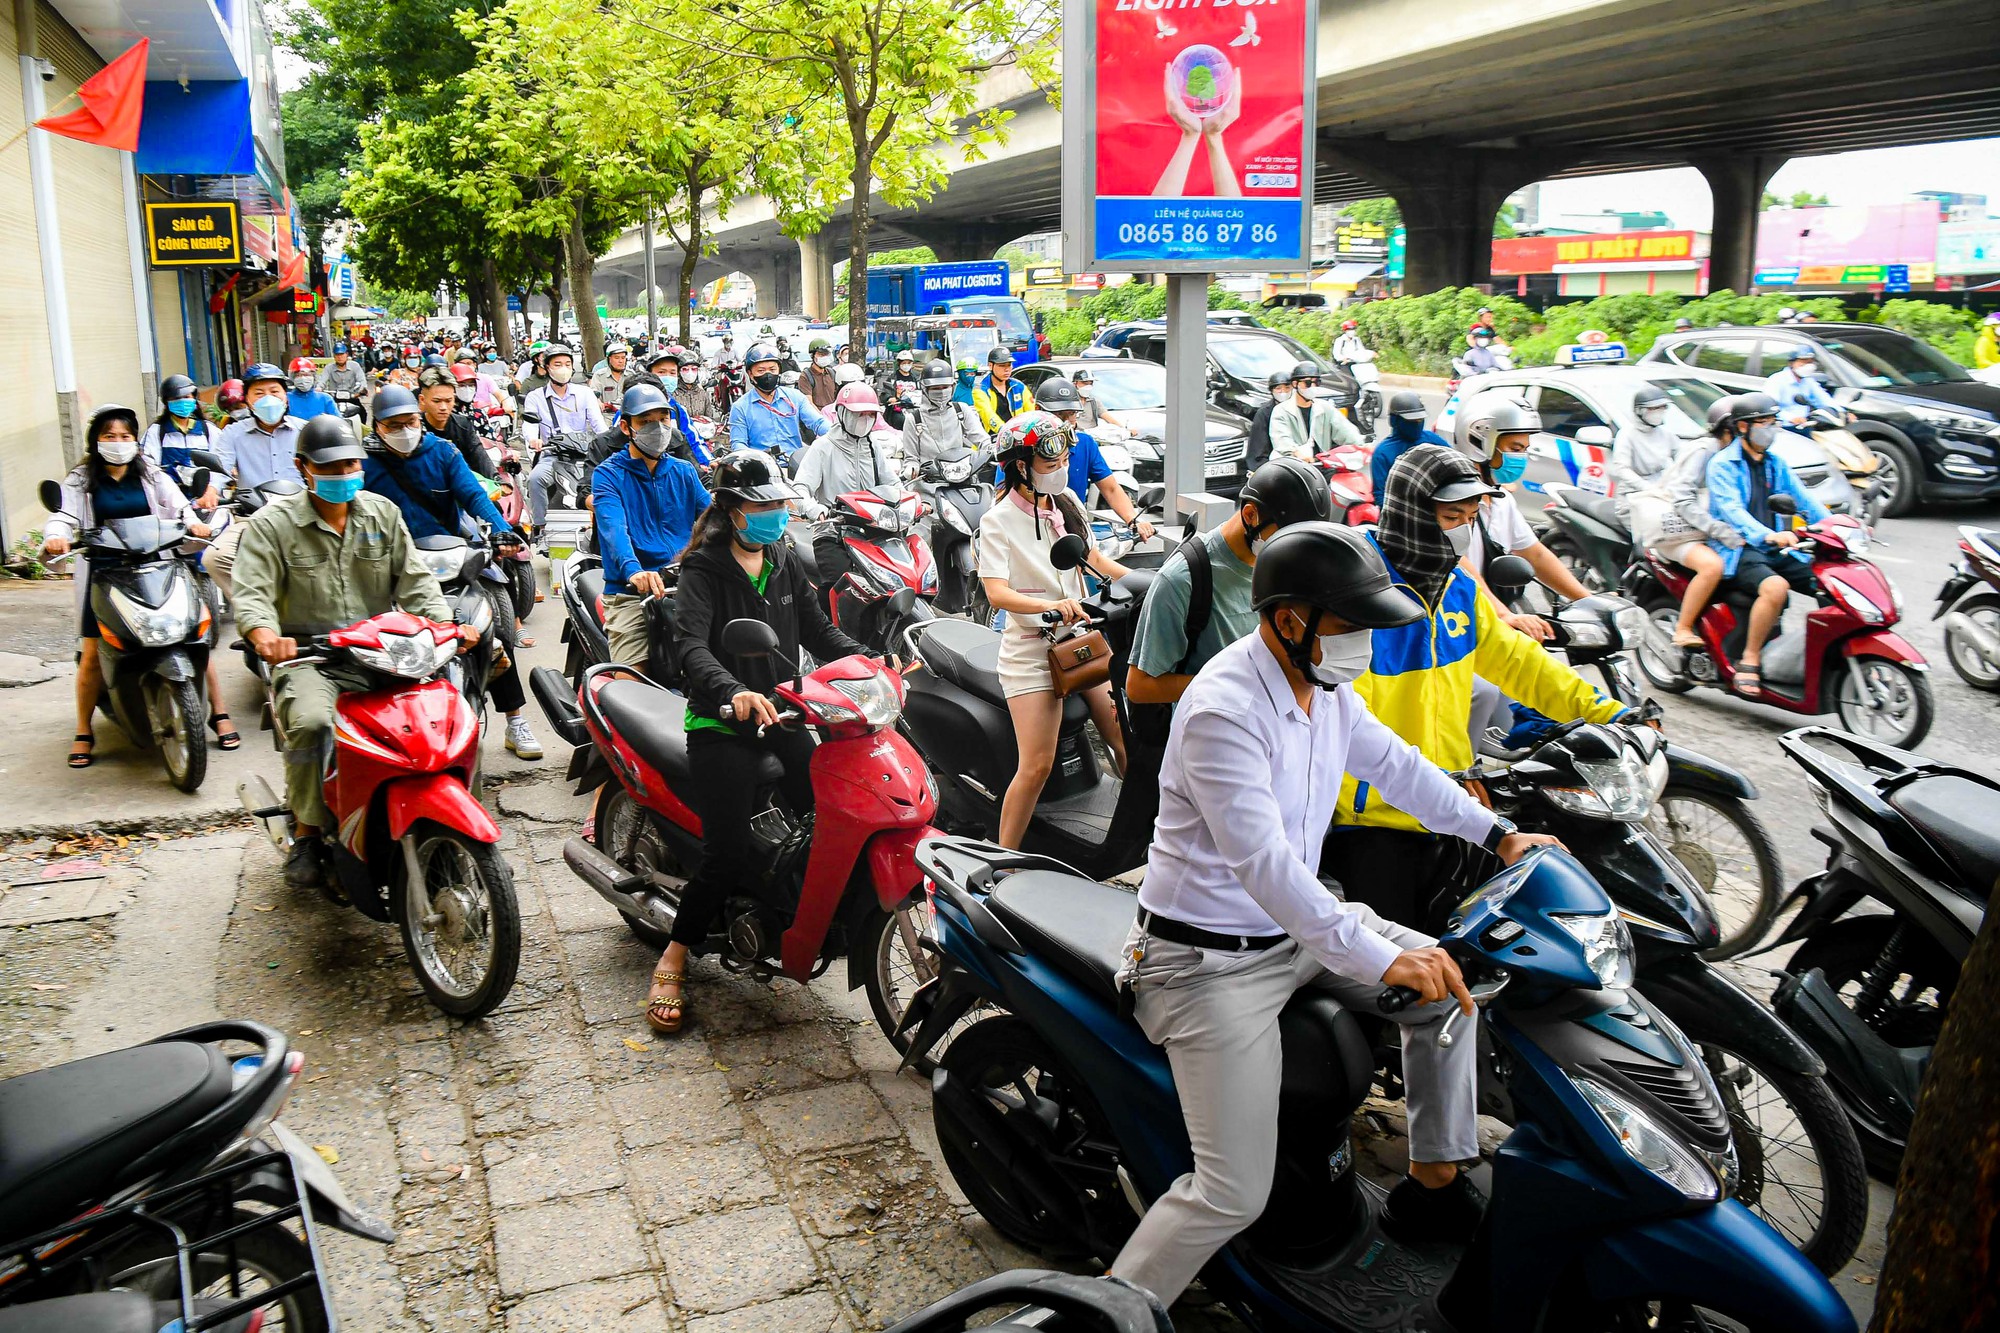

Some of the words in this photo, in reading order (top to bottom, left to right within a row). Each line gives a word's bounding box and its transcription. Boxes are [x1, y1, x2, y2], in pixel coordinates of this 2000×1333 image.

[1261, 175, 1291, 186] GODA
[1154, 207, 1176, 218] LIÊN
[1178, 207, 1190, 220] HỆ
[1192, 207, 1223, 219] QUẢNG
[1225, 207, 1244, 218] CÁO
[172, 217, 197, 231] SÀN
[197, 214, 215, 231] GỖ
[1119, 223, 1174, 243] 0865
[1181, 223, 1209, 243] 86
[1216, 223, 1243, 243] 87
[1251, 223, 1277, 243] 86
[157, 236, 189, 250] CÔNG
[190, 235, 231, 251] NGHIỆP
[1639, 236, 1689, 258] AUTO
[924, 278, 942, 291] HOA
[942, 275, 962, 289] PHAT
[962, 273, 1003, 288] LOGISTICS
